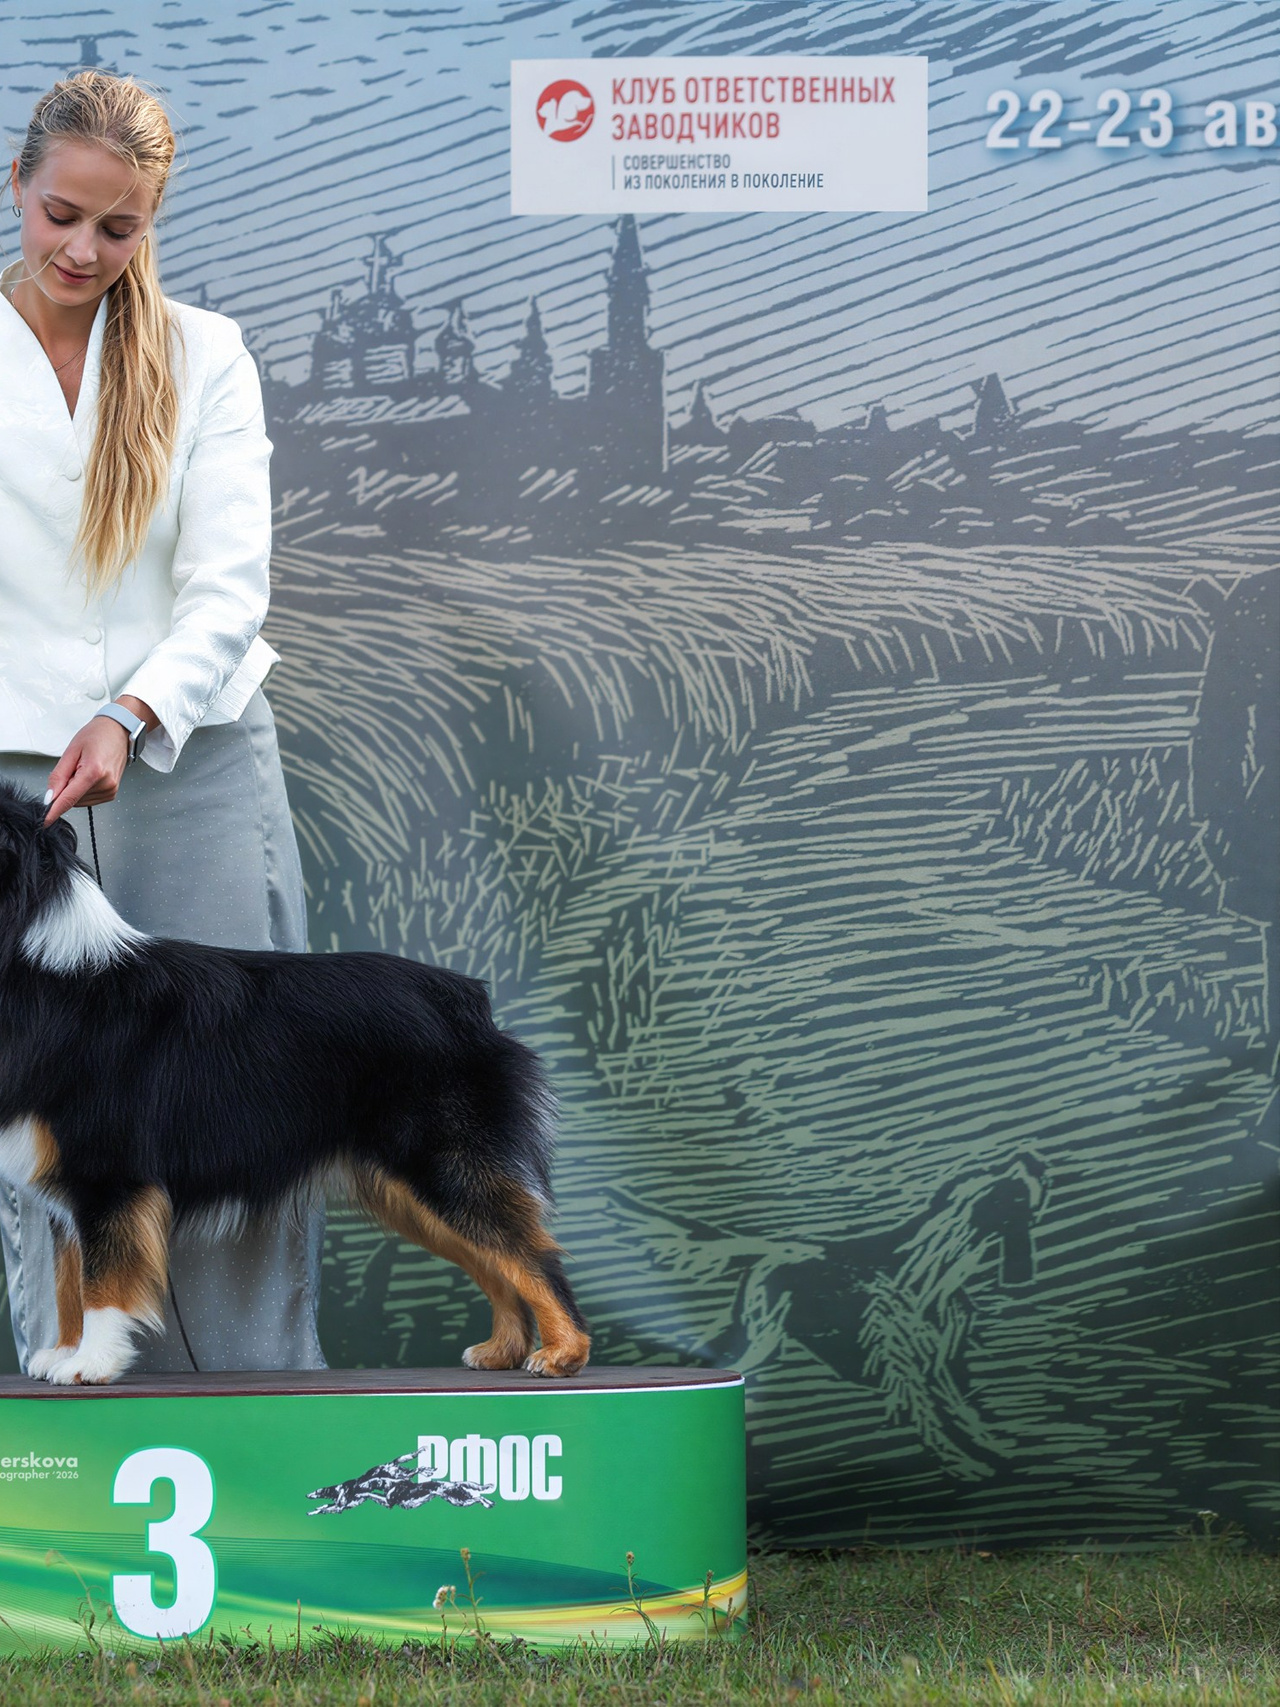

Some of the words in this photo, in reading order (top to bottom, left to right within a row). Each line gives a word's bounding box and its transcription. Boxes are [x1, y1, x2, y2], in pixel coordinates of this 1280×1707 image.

[611, 77, 676, 105] КЛУБ
[684, 76, 896, 104] ОТВЕТСТВЕННЫХ
[611, 112, 781, 143] ЗАВОДЧИКОВ
[985, 87, 1174, 149] 22-23
[1203, 100, 1278, 148] ав
[623, 153, 732, 171] СОВЕРШЕНСТВО
[623, 175, 641, 190] ИЗ
[644, 174, 727, 190] ПОКОЛЕНИЯ
[730, 174, 740, 189] В
[743, 173, 825, 189] ПОКОЛЕНИЕ
[417, 1434, 563, 1501] РФОС
[110, 1445, 218, 1641] 3
